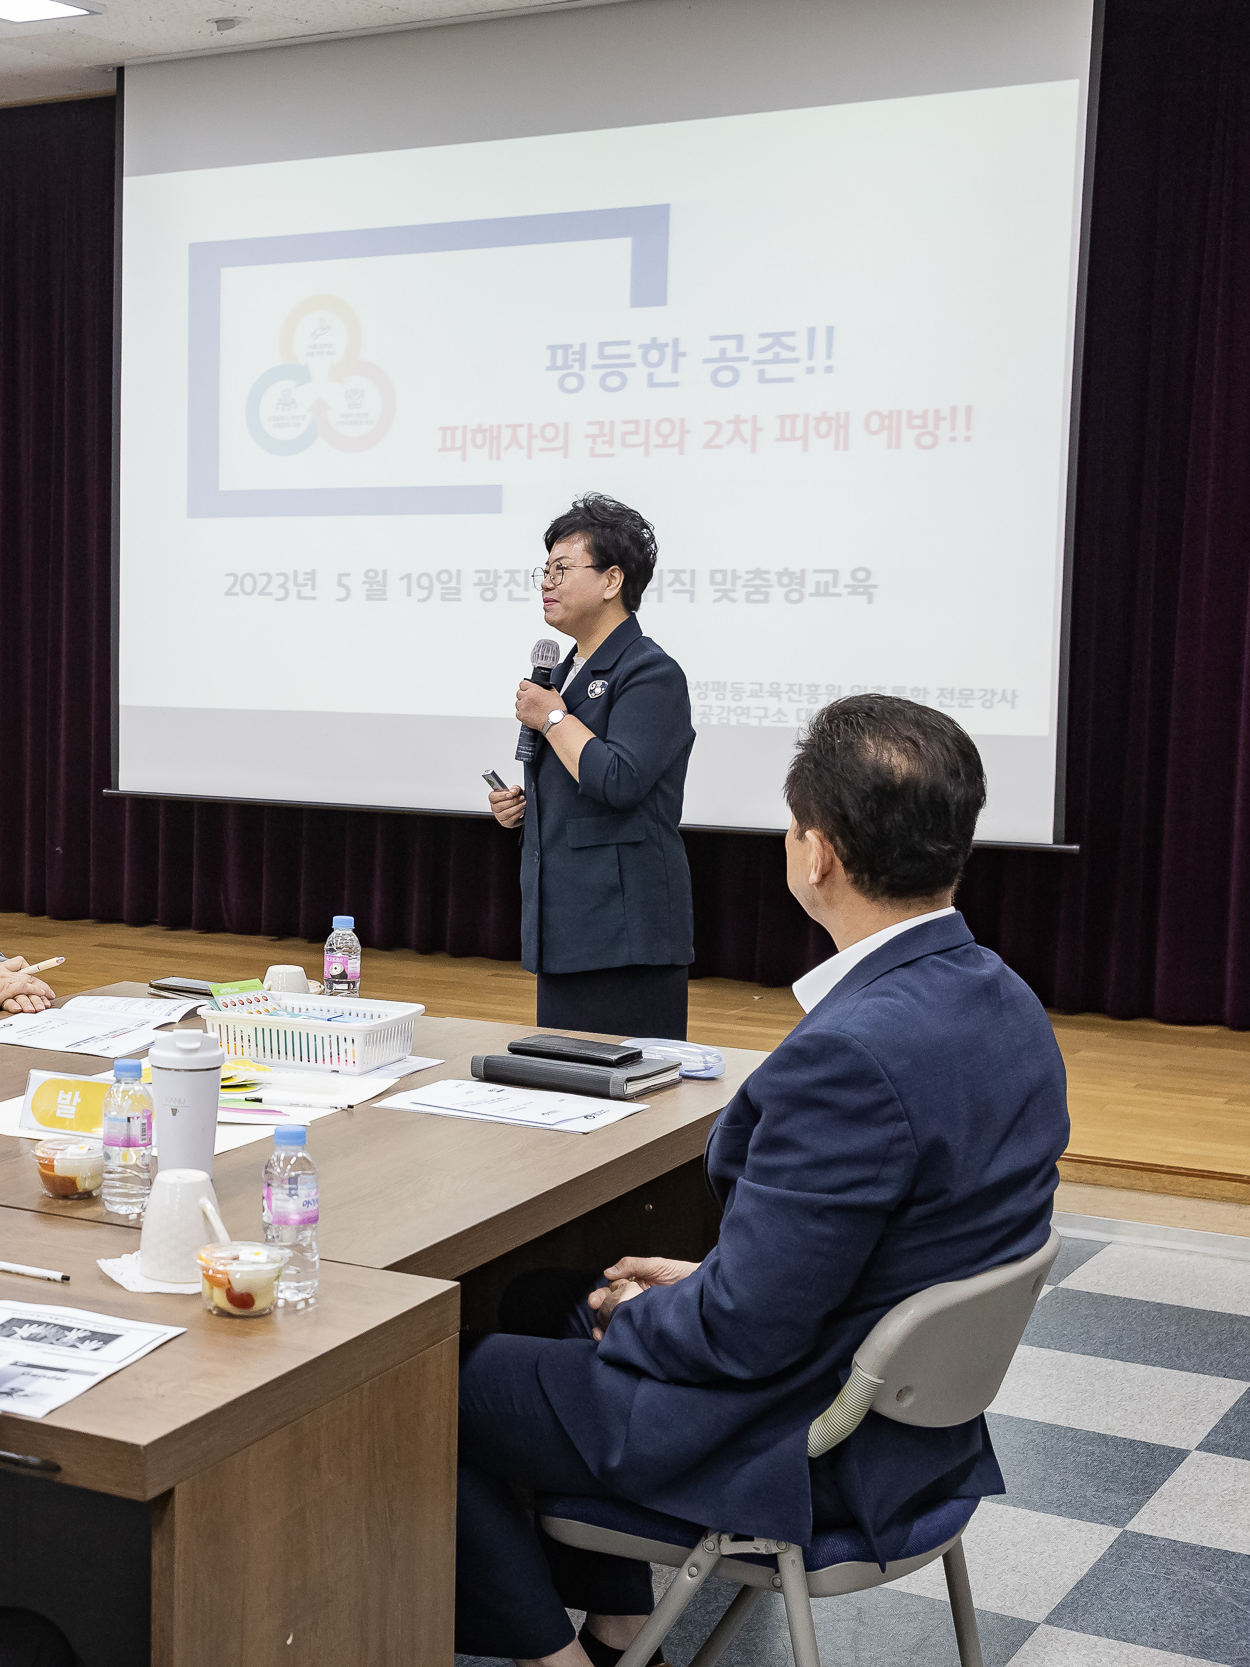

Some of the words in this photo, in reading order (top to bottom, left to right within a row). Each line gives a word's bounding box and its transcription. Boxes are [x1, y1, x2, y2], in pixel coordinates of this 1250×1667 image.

[545, 336, 688, 394] 평등한
[701, 325, 836, 389] 공존!!
[437, 420, 570, 462] 피해자의
[583, 416, 691, 458] 권리와
[702, 414, 764, 454] 2차
[775, 410, 850, 453] 피해
[863, 404, 974, 450] 예방!!
[224, 568, 317, 602] 2023년
[335, 572, 352, 602] 5
[362, 568, 388, 602] 월
[399, 569, 463, 603] 19일
[472, 569, 532, 603] 광진
[709, 566, 879, 605] 맞춤형교육
[688, 680, 841, 705] 성평등교육진흥원
[936, 686, 1019, 710] 전문강사
[691, 704, 789, 726] 공감연구소
[56, 1089, 82, 1119] 발
[164, 1096, 186, 1105] KANU
